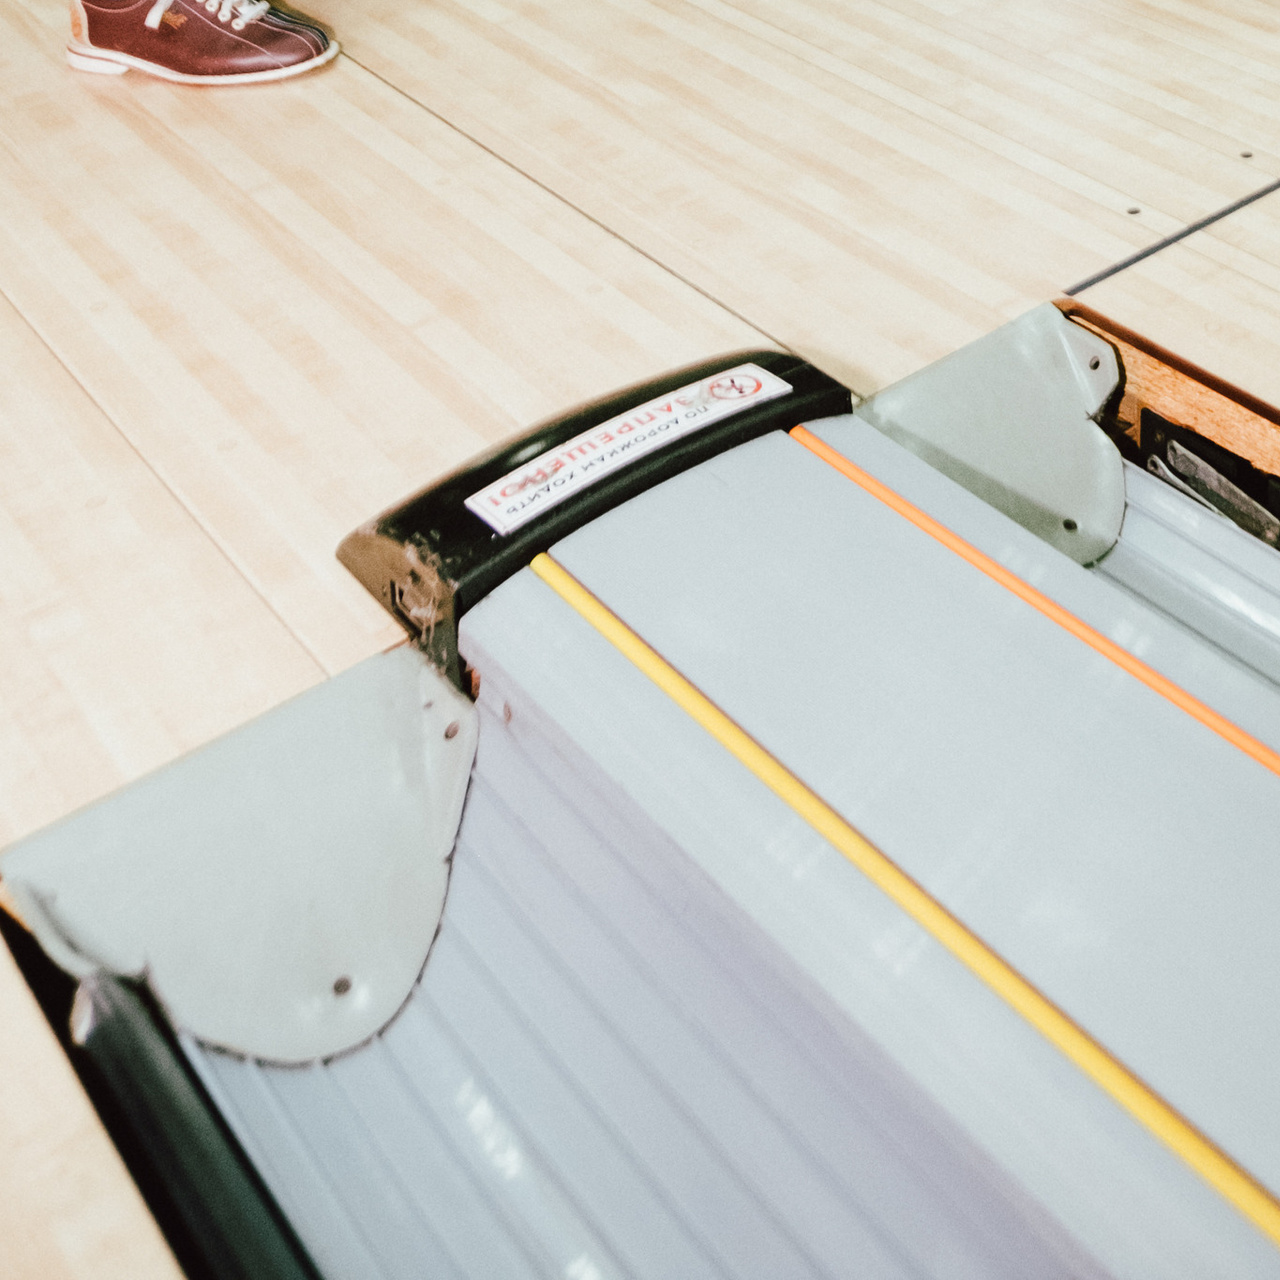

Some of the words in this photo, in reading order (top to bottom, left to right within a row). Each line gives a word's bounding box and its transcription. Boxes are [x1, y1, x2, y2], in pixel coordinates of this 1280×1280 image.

[685, 405, 709, 419] ПО
[581, 417, 680, 472] ДОРОЖКАМ
[506, 470, 576, 515] ХОДИТЬ
